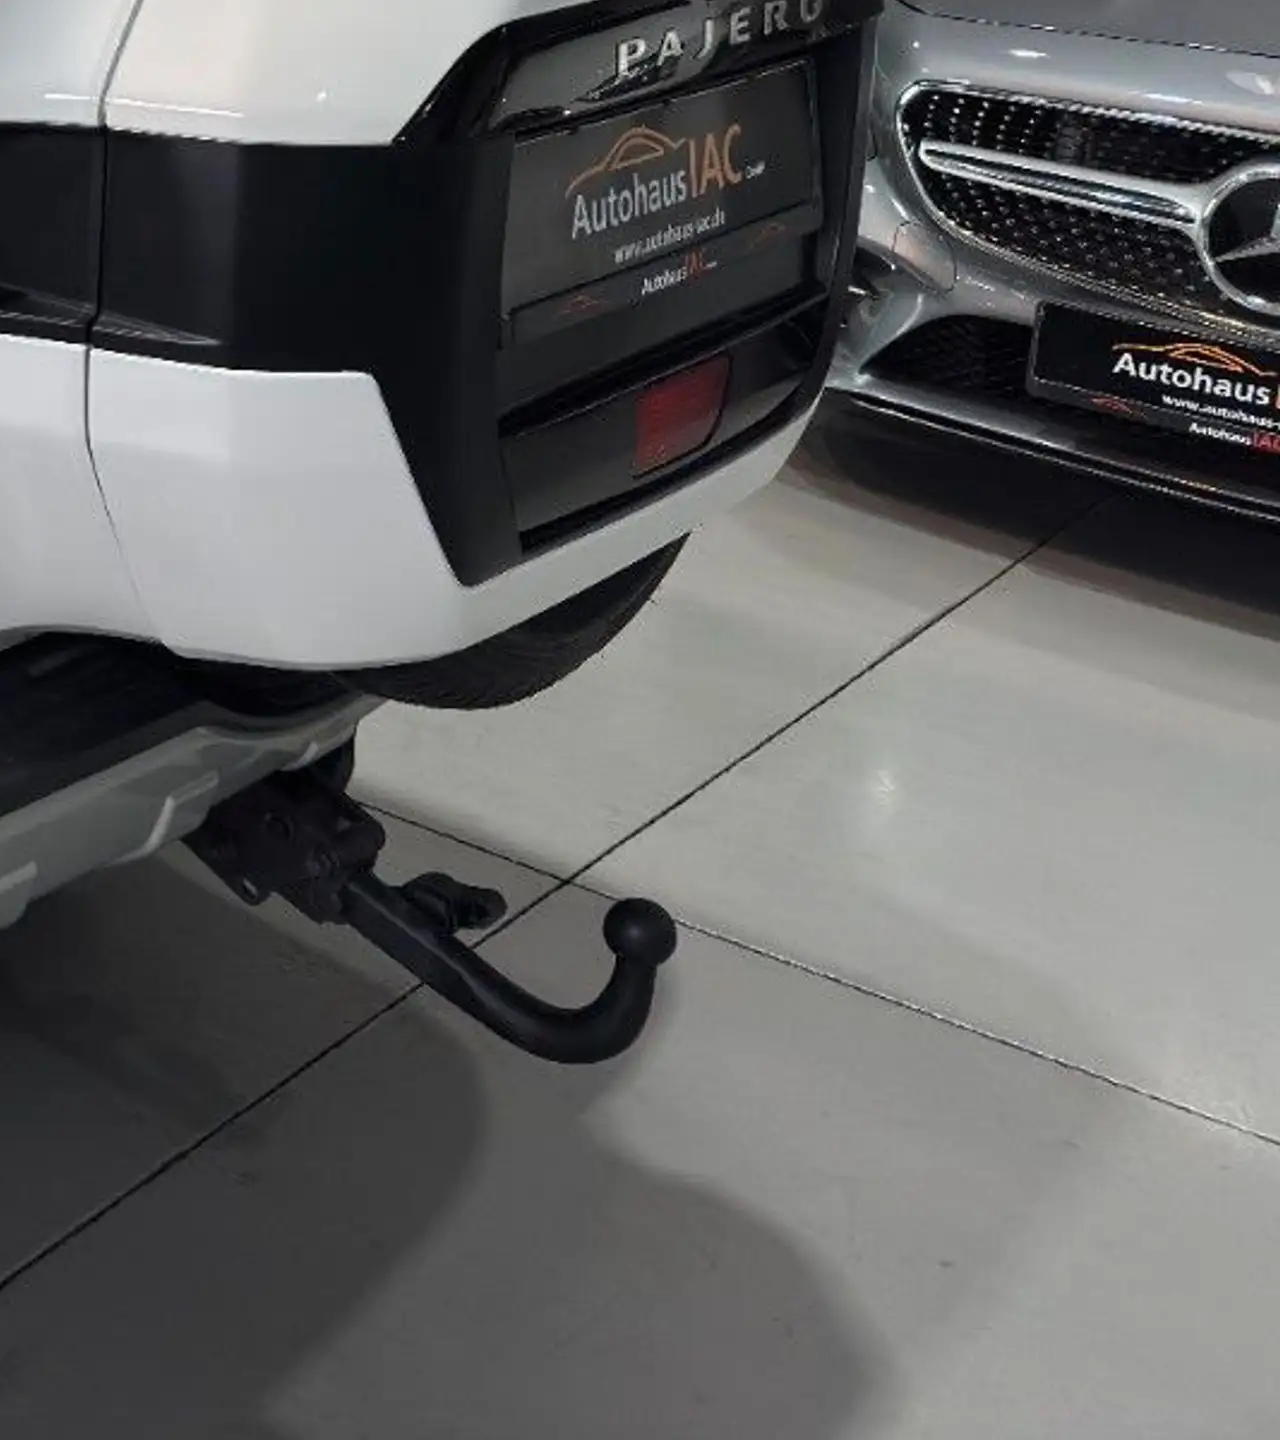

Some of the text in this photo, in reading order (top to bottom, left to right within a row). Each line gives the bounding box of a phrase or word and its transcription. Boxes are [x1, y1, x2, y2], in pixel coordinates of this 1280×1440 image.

[571, 122, 743, 241] Autohaus IAC
[640, 265, 688, 297] Autohaus
[1111, 352, 1273, 406] Autohaus
[1188, 422, 1253, 447] Autohaus
